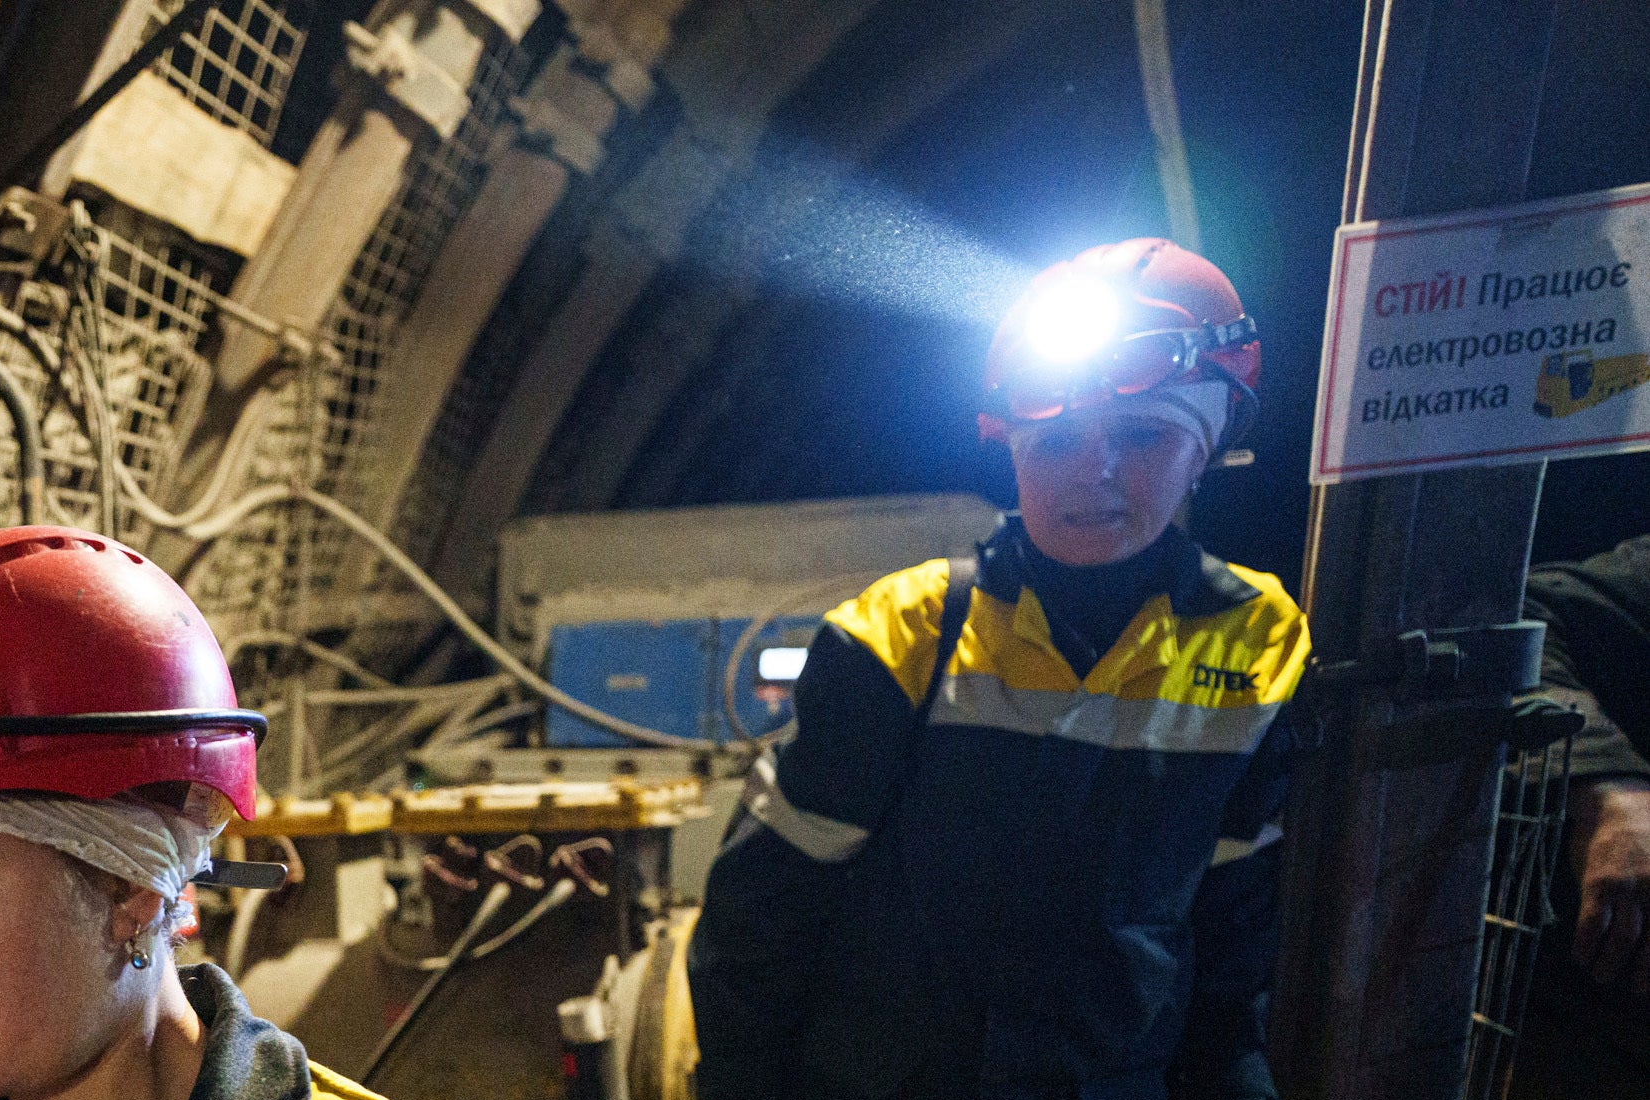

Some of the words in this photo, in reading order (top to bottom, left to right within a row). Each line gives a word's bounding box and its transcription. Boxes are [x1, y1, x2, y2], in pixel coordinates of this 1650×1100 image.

[1374, 270, 1467, 318] СТІЙ!
[1478, 262, 1632, 308] Працює
[1367, 317, 1618, 371] електровозна
[1361, 382, 1510, 424] відкатка
